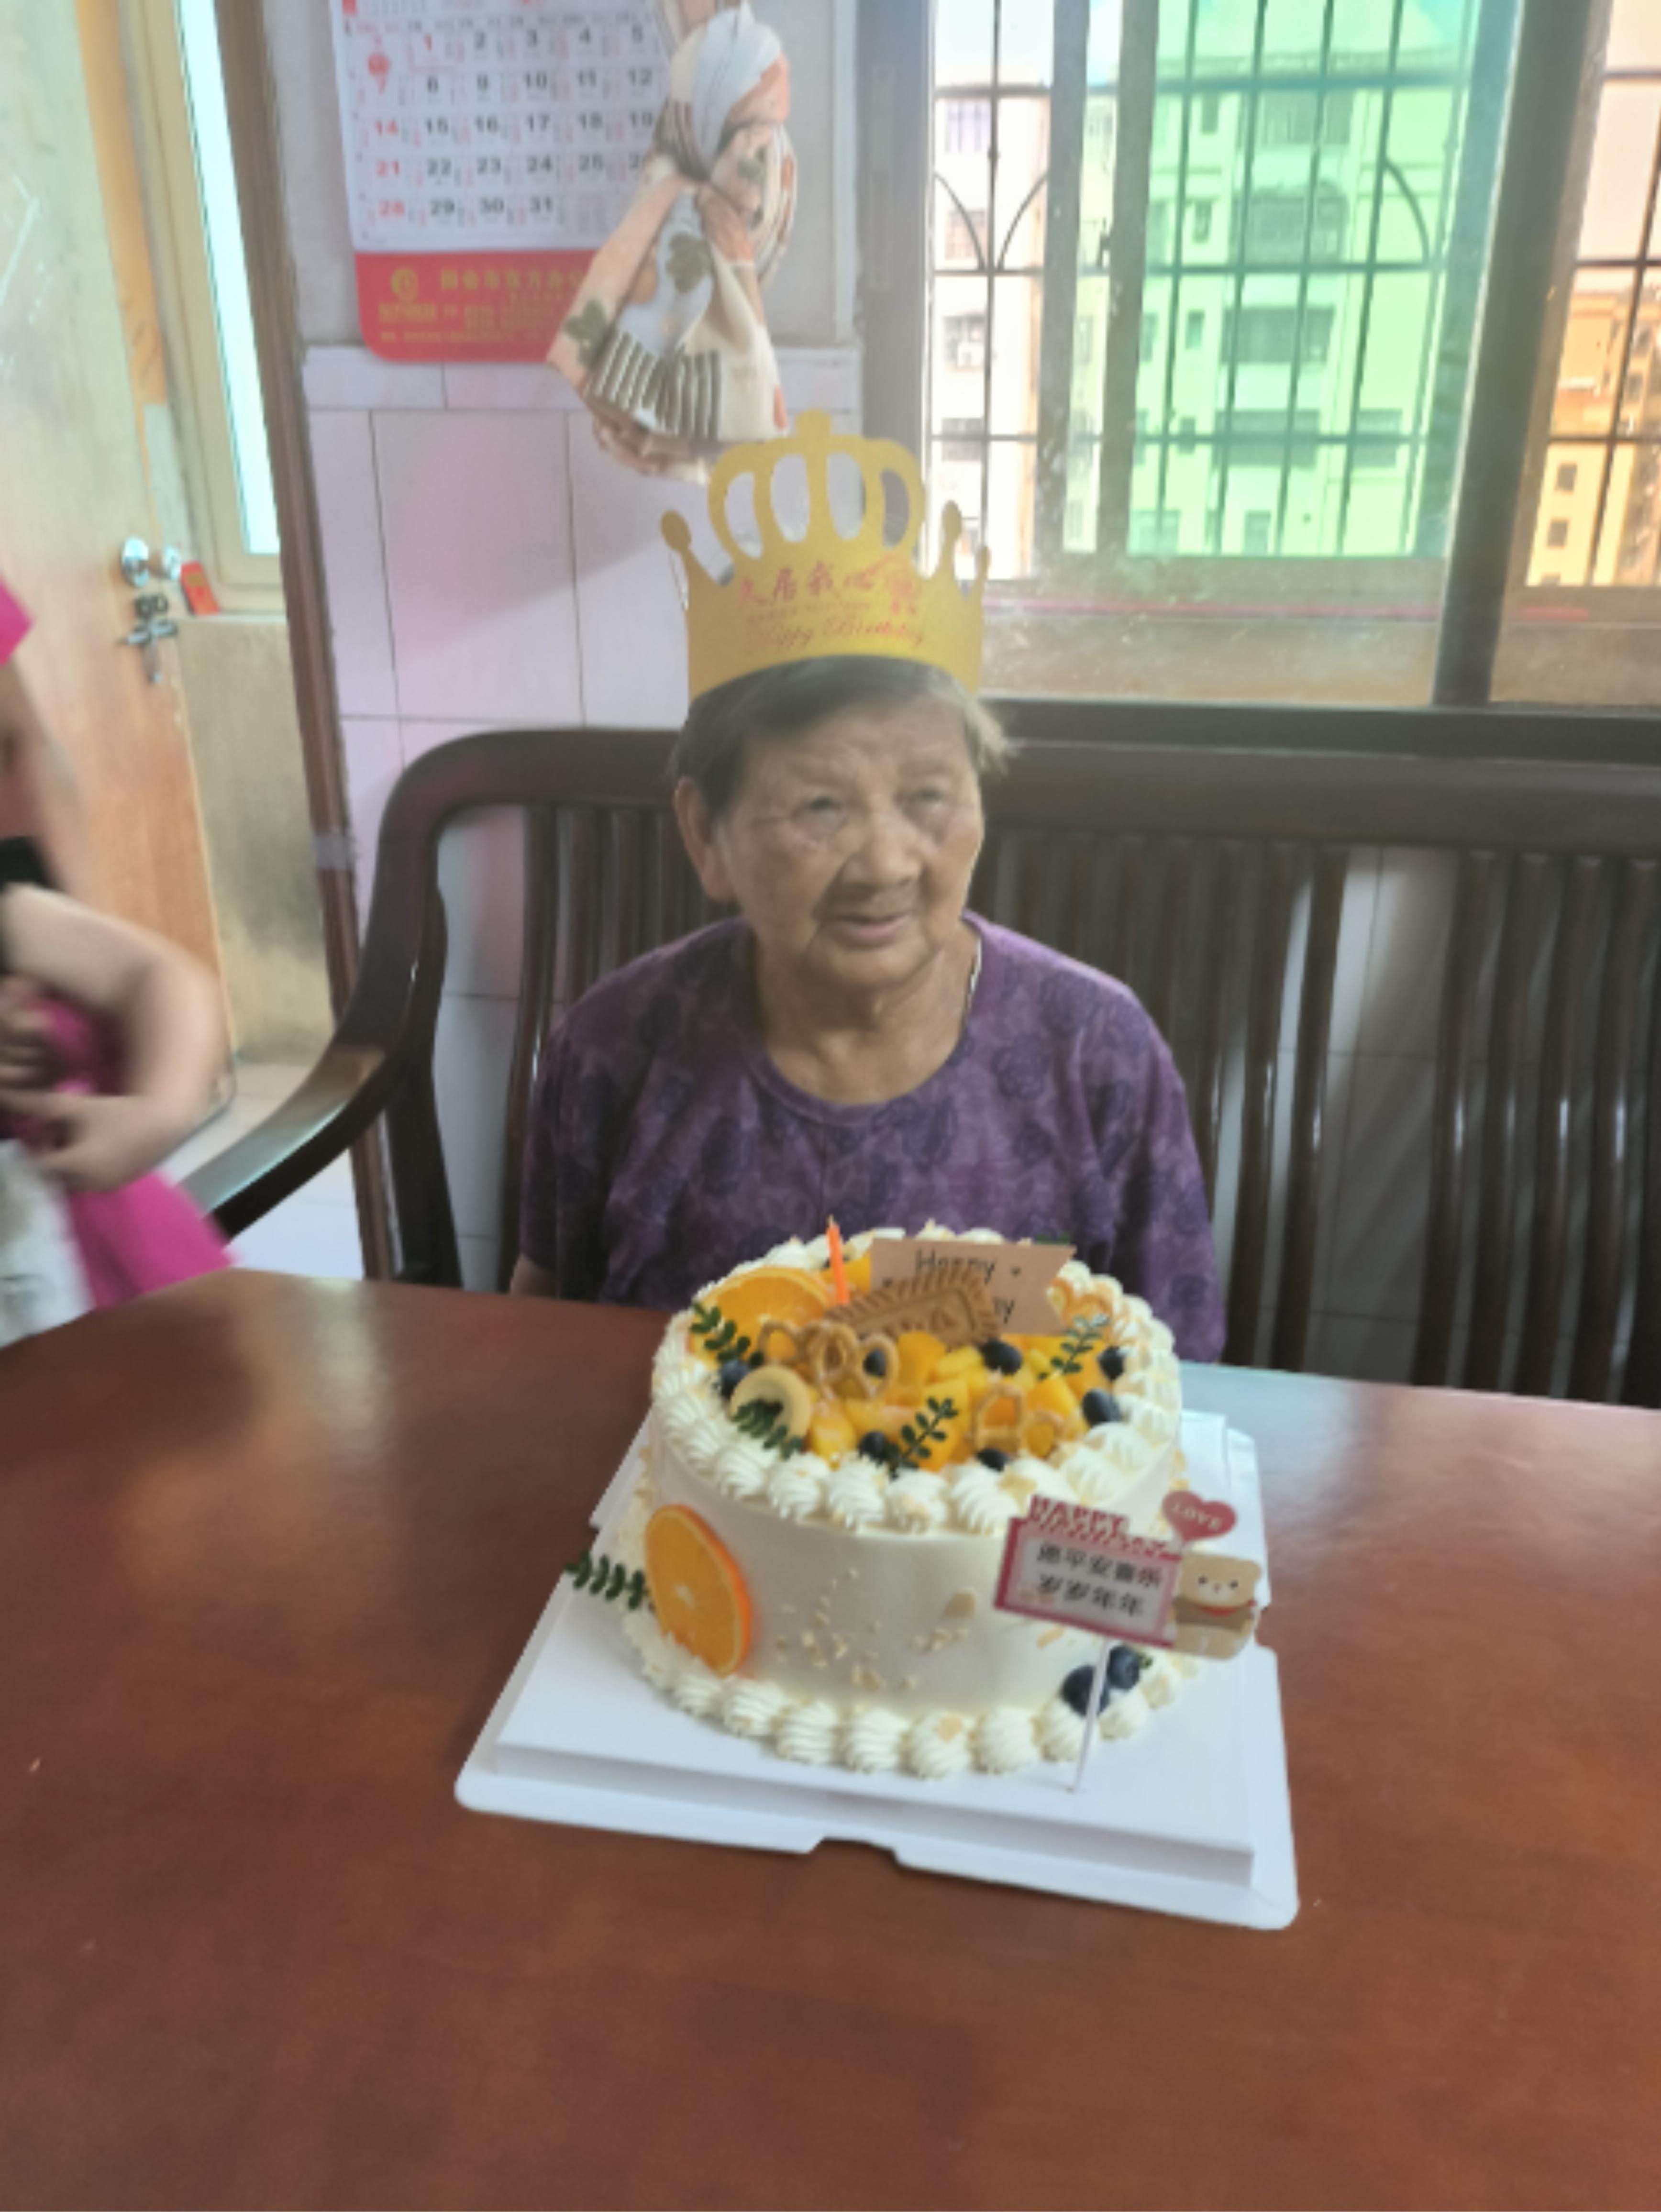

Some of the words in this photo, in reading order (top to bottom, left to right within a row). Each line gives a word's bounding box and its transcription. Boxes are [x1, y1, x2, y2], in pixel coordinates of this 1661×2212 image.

[526, 72, 547, 89] 10
[577, 70, 597, 87] 11
[627, 68, 653, 85] 12
[375, 120, 398, 136] 14
[426, 118, 449, 133] 15
[475, 115, 498, 132] 16
[527, 114, 550, 131] 17
[578, 112, 602, 129] 18
[629, 110, 653, 128] 19
[377, 160, 399, 177] 21
[428, 160, 452, 176] 22
[476, 158, 501, 175] 23
[527, 156, 552, 172] 24
[578, 154, 603, 172] 25
[378, 201, 404, 217] 28
[432, 199, 455, 215] 29
[479, 199, 504, 214] 30
[529, 197, 552, 213] 31
[1171, 1503, 1223, 1530] LOVE
